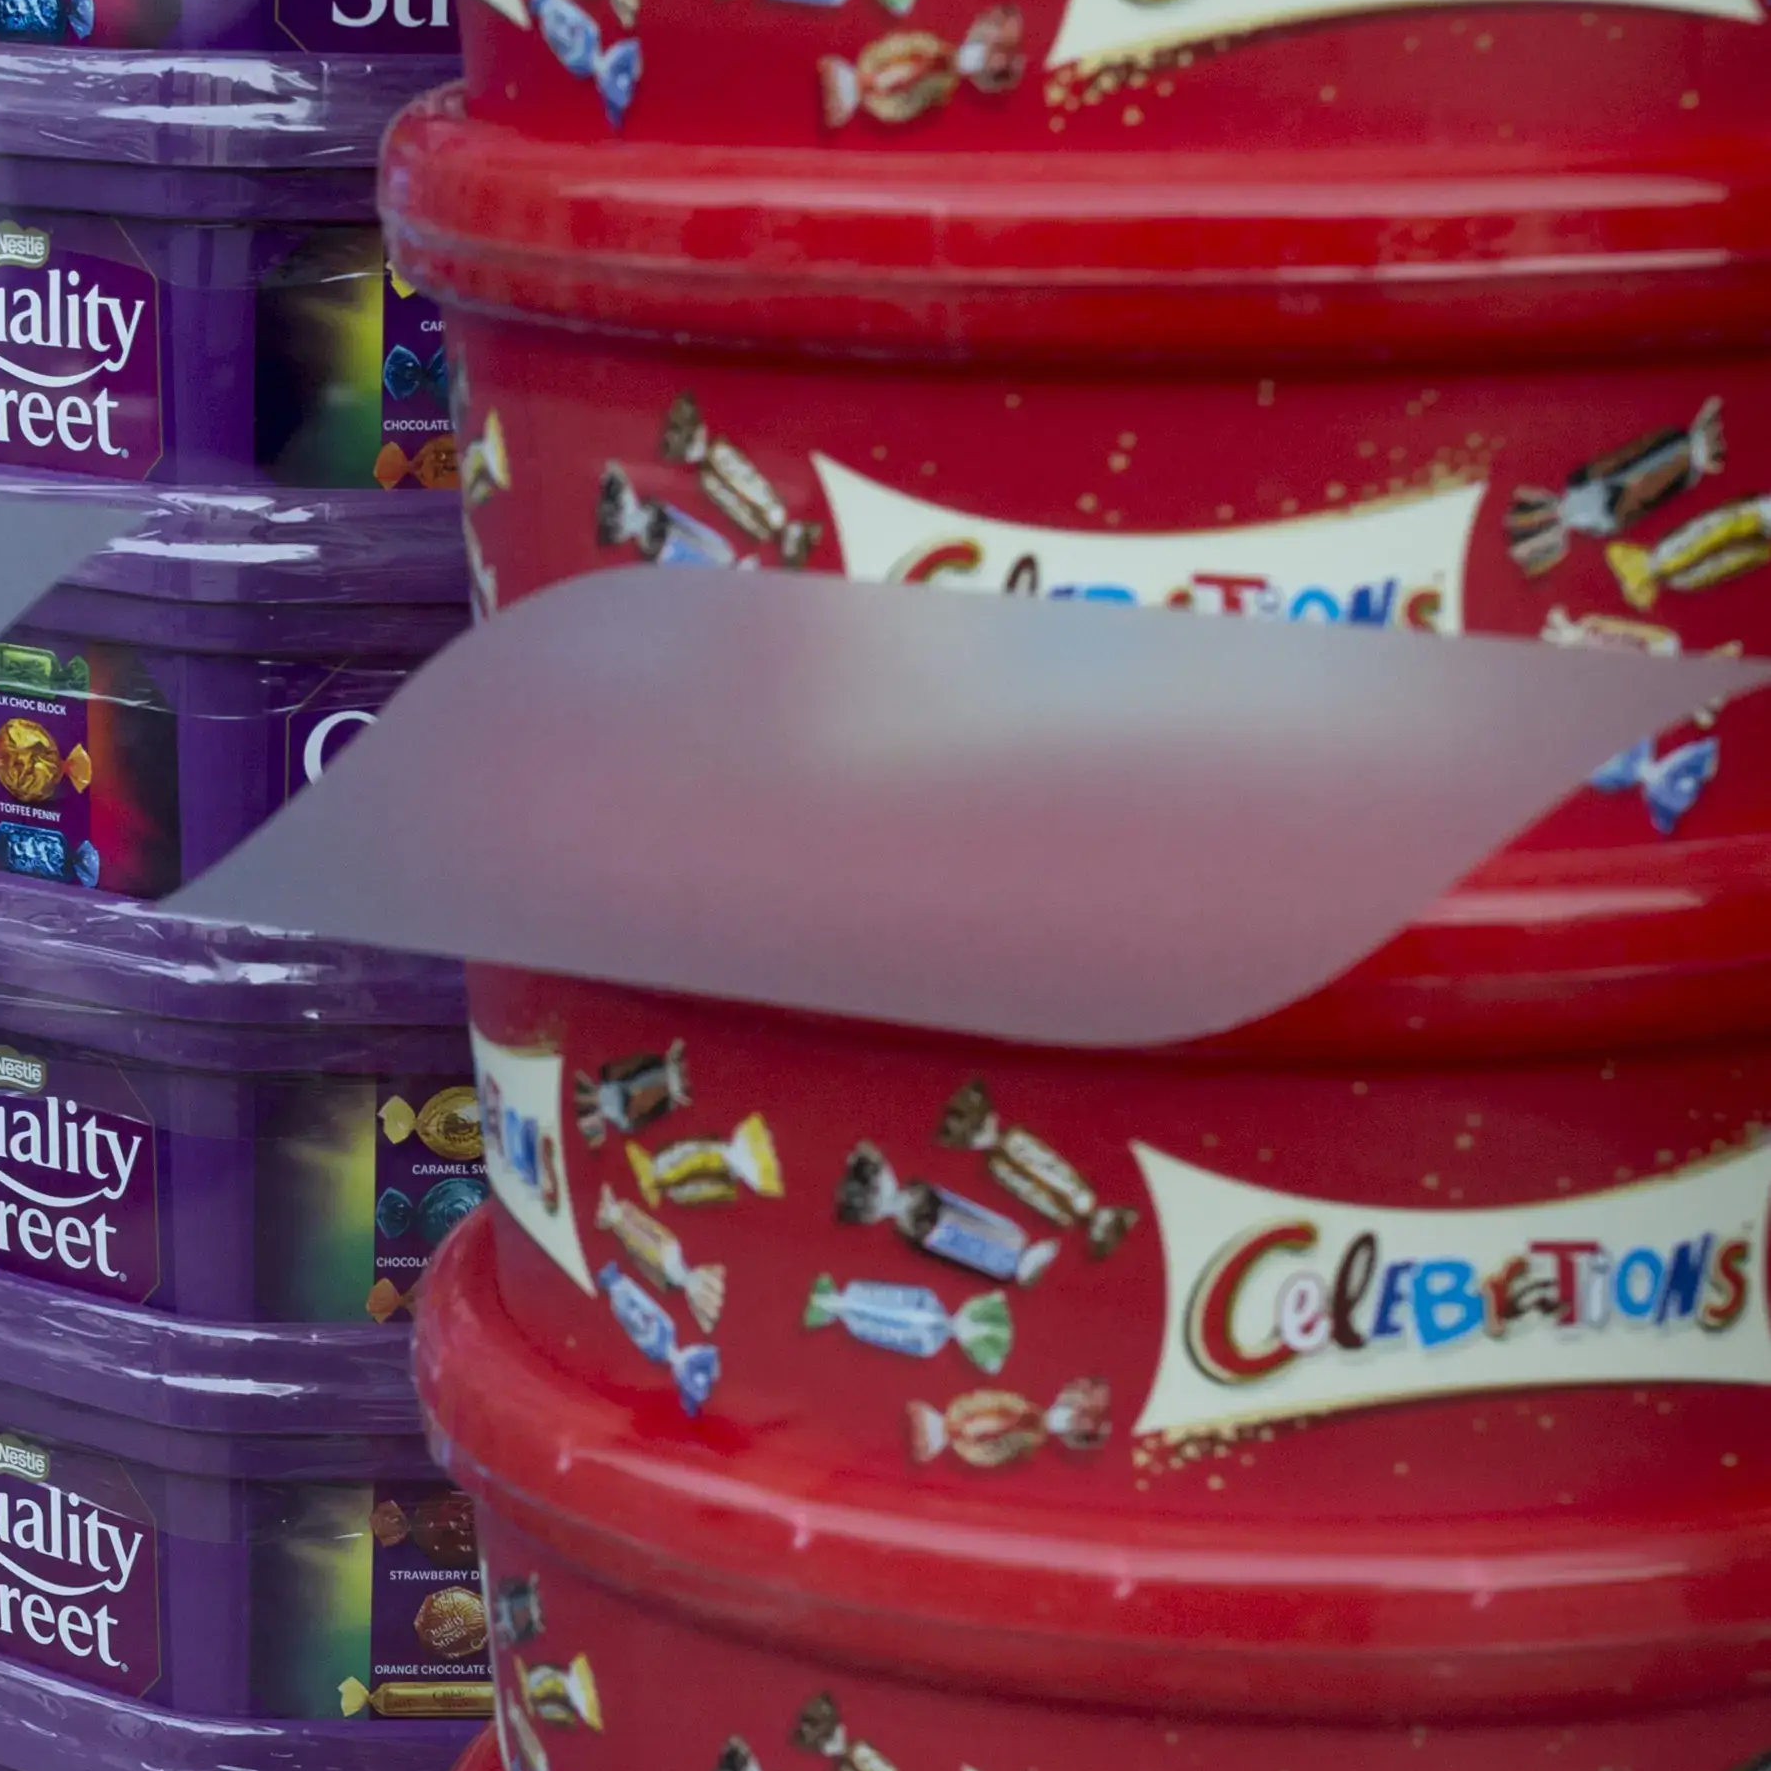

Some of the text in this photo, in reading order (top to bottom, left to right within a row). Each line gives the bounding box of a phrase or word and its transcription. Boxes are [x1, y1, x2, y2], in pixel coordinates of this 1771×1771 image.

[383, 419, 449, 432] CHOCOLATE
[12, 696, 35, 711] CHOC
[36, 699, 67, 716] BLOCK
[0, 802, 62, 822] TOFFEE PENNY
[412, 1163, 469, 1176] CARAMEL
[376, 1256, 431, 1268] CHOCOLA
[389, 1569, 469, 1582] STRAWBERRY
[375, 1664, 485, 1676] ORANGE CHOCOLATE
